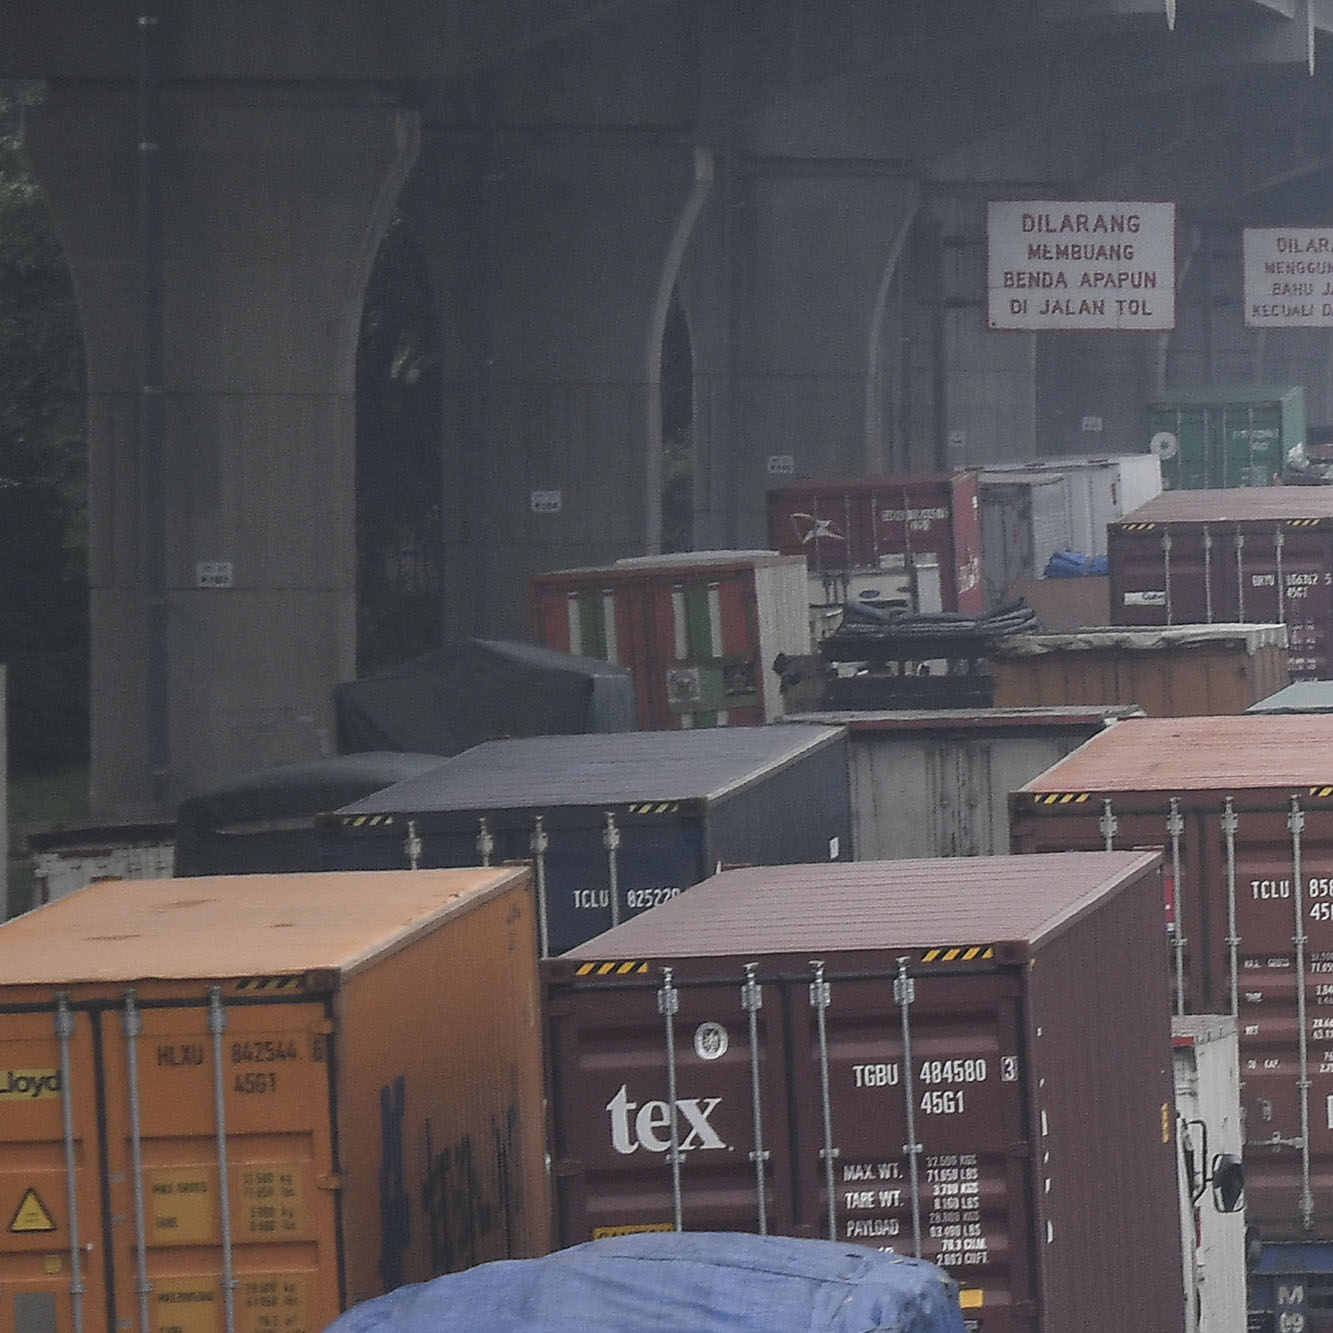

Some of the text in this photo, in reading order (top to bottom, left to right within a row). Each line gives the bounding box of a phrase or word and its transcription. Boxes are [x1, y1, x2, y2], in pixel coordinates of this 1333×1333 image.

[1021, 213, 1141, 234] DILARANG
[1026, 243, 1135, 261] MEMBUANG
[1003, 271, 1157, 290] BENDA APAPUN
[1271, 281, 1314, 296] BAHU
[1009, 298, 1153, 316] DI JALAN TOL
[1251, 303, 1314, 318] KECUALI
[573, 889, 609, 908] TCLU
[1250, 879, 1291, 900] TCLU
[852, 1058, 1016, 1088] TGBU 484580 3
[920, 1090, 966, 1114] 45G1
[844, 1191, 876, 1210] TARE
[846, 1218, 900, 1238] PAYLOAD
